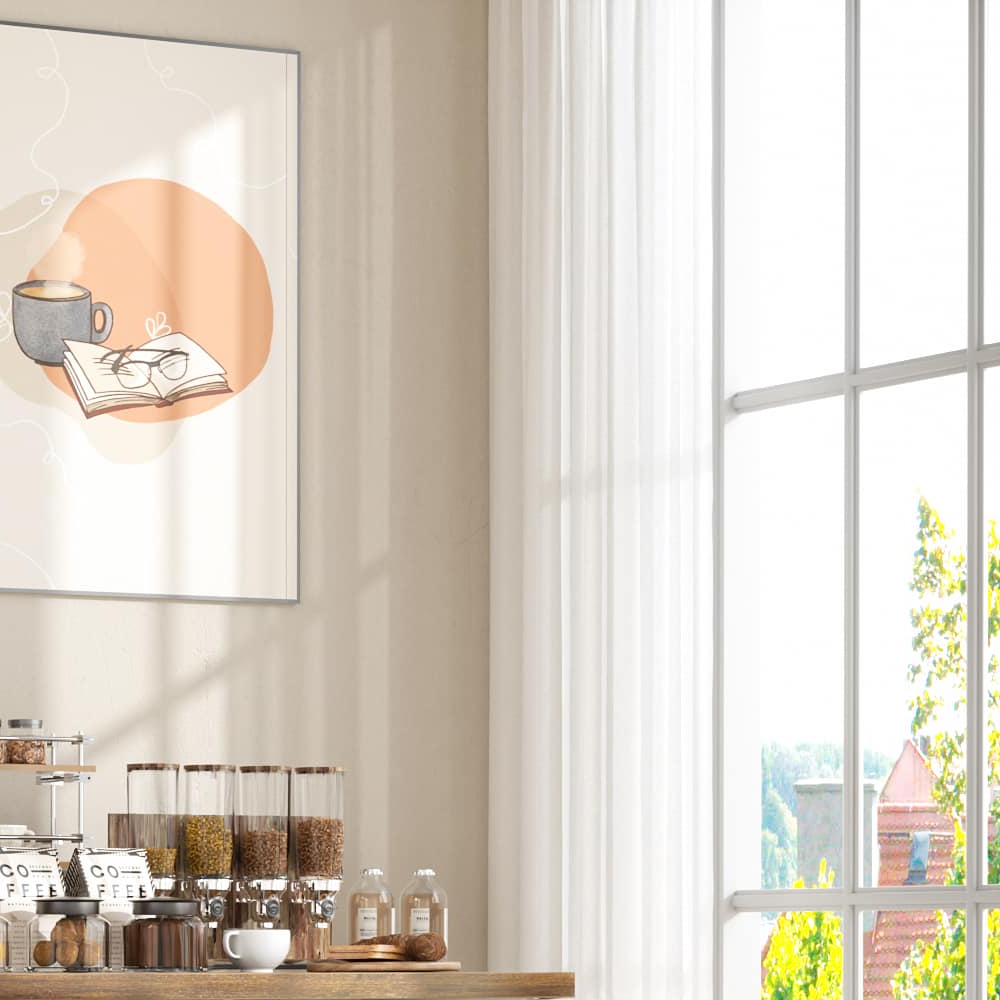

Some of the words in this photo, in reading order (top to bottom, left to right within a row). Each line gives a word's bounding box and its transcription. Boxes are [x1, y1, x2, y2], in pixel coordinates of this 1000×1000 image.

[0, 864, 29, 878] CO
[90, 865, 118, 878] CO
[6, 883, 58, 898] FFEE
